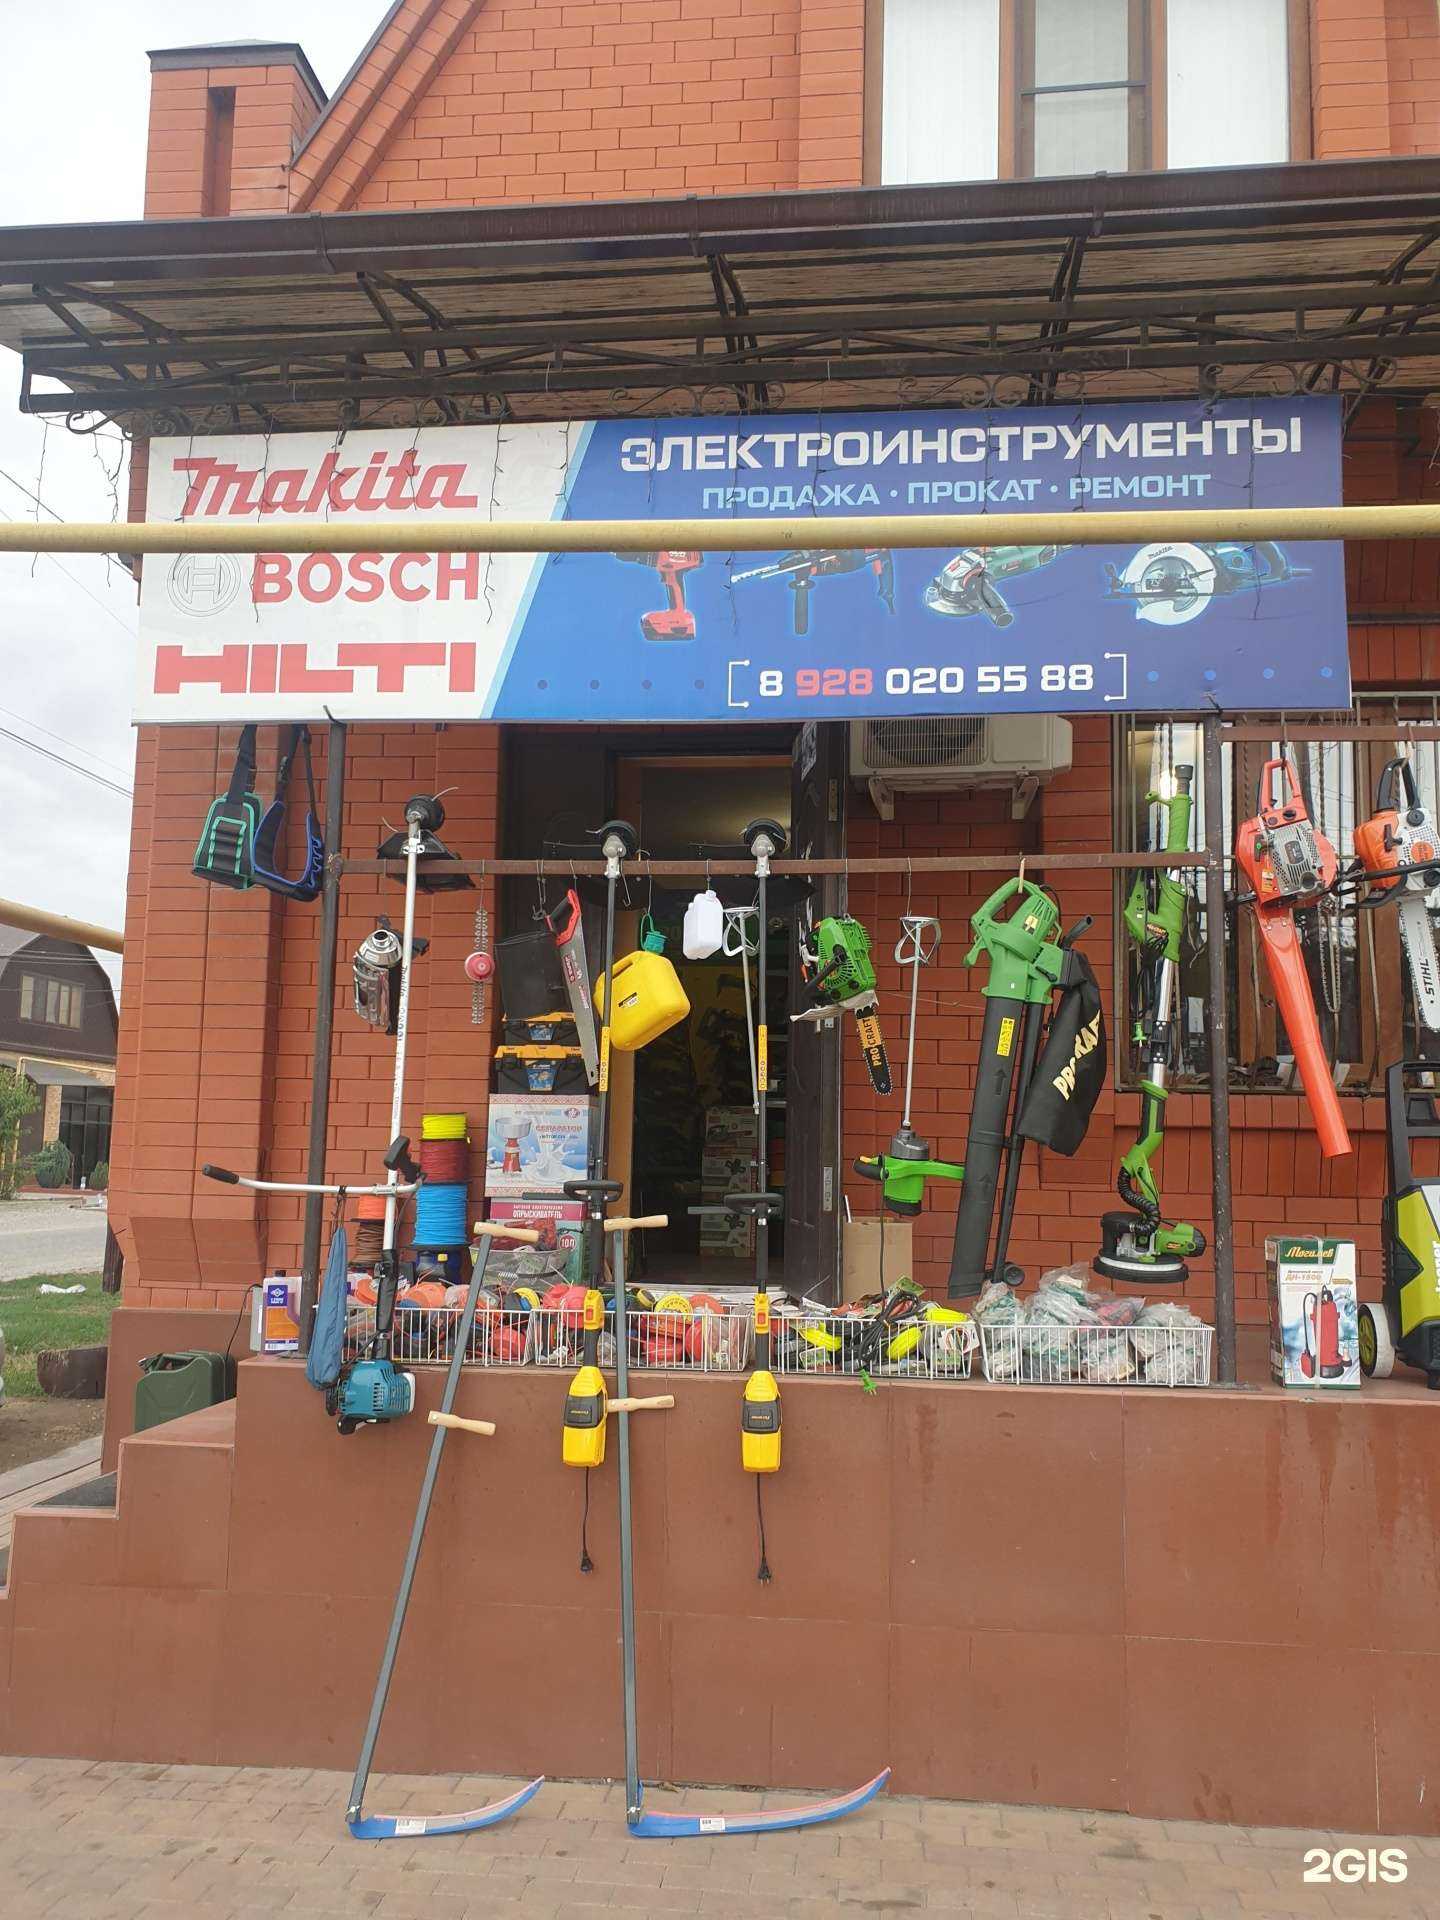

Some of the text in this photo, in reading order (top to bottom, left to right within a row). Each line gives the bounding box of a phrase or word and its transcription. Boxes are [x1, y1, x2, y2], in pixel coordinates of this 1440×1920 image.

[620, 417, 1302, 472] ЭЛЕКТРОИНСТРУМЕНТЫ
[702, 473, 1211, 510] ПРОДАЖА ПРОКАТ РЕМОНТ
[252, 551, 479, 603] BOSCH
[154, 642, 476, 693] HILTI
[759, 664, 1094, 698] 8 928 020 55 88
[1420, 958, 1435, 996] STIHL
